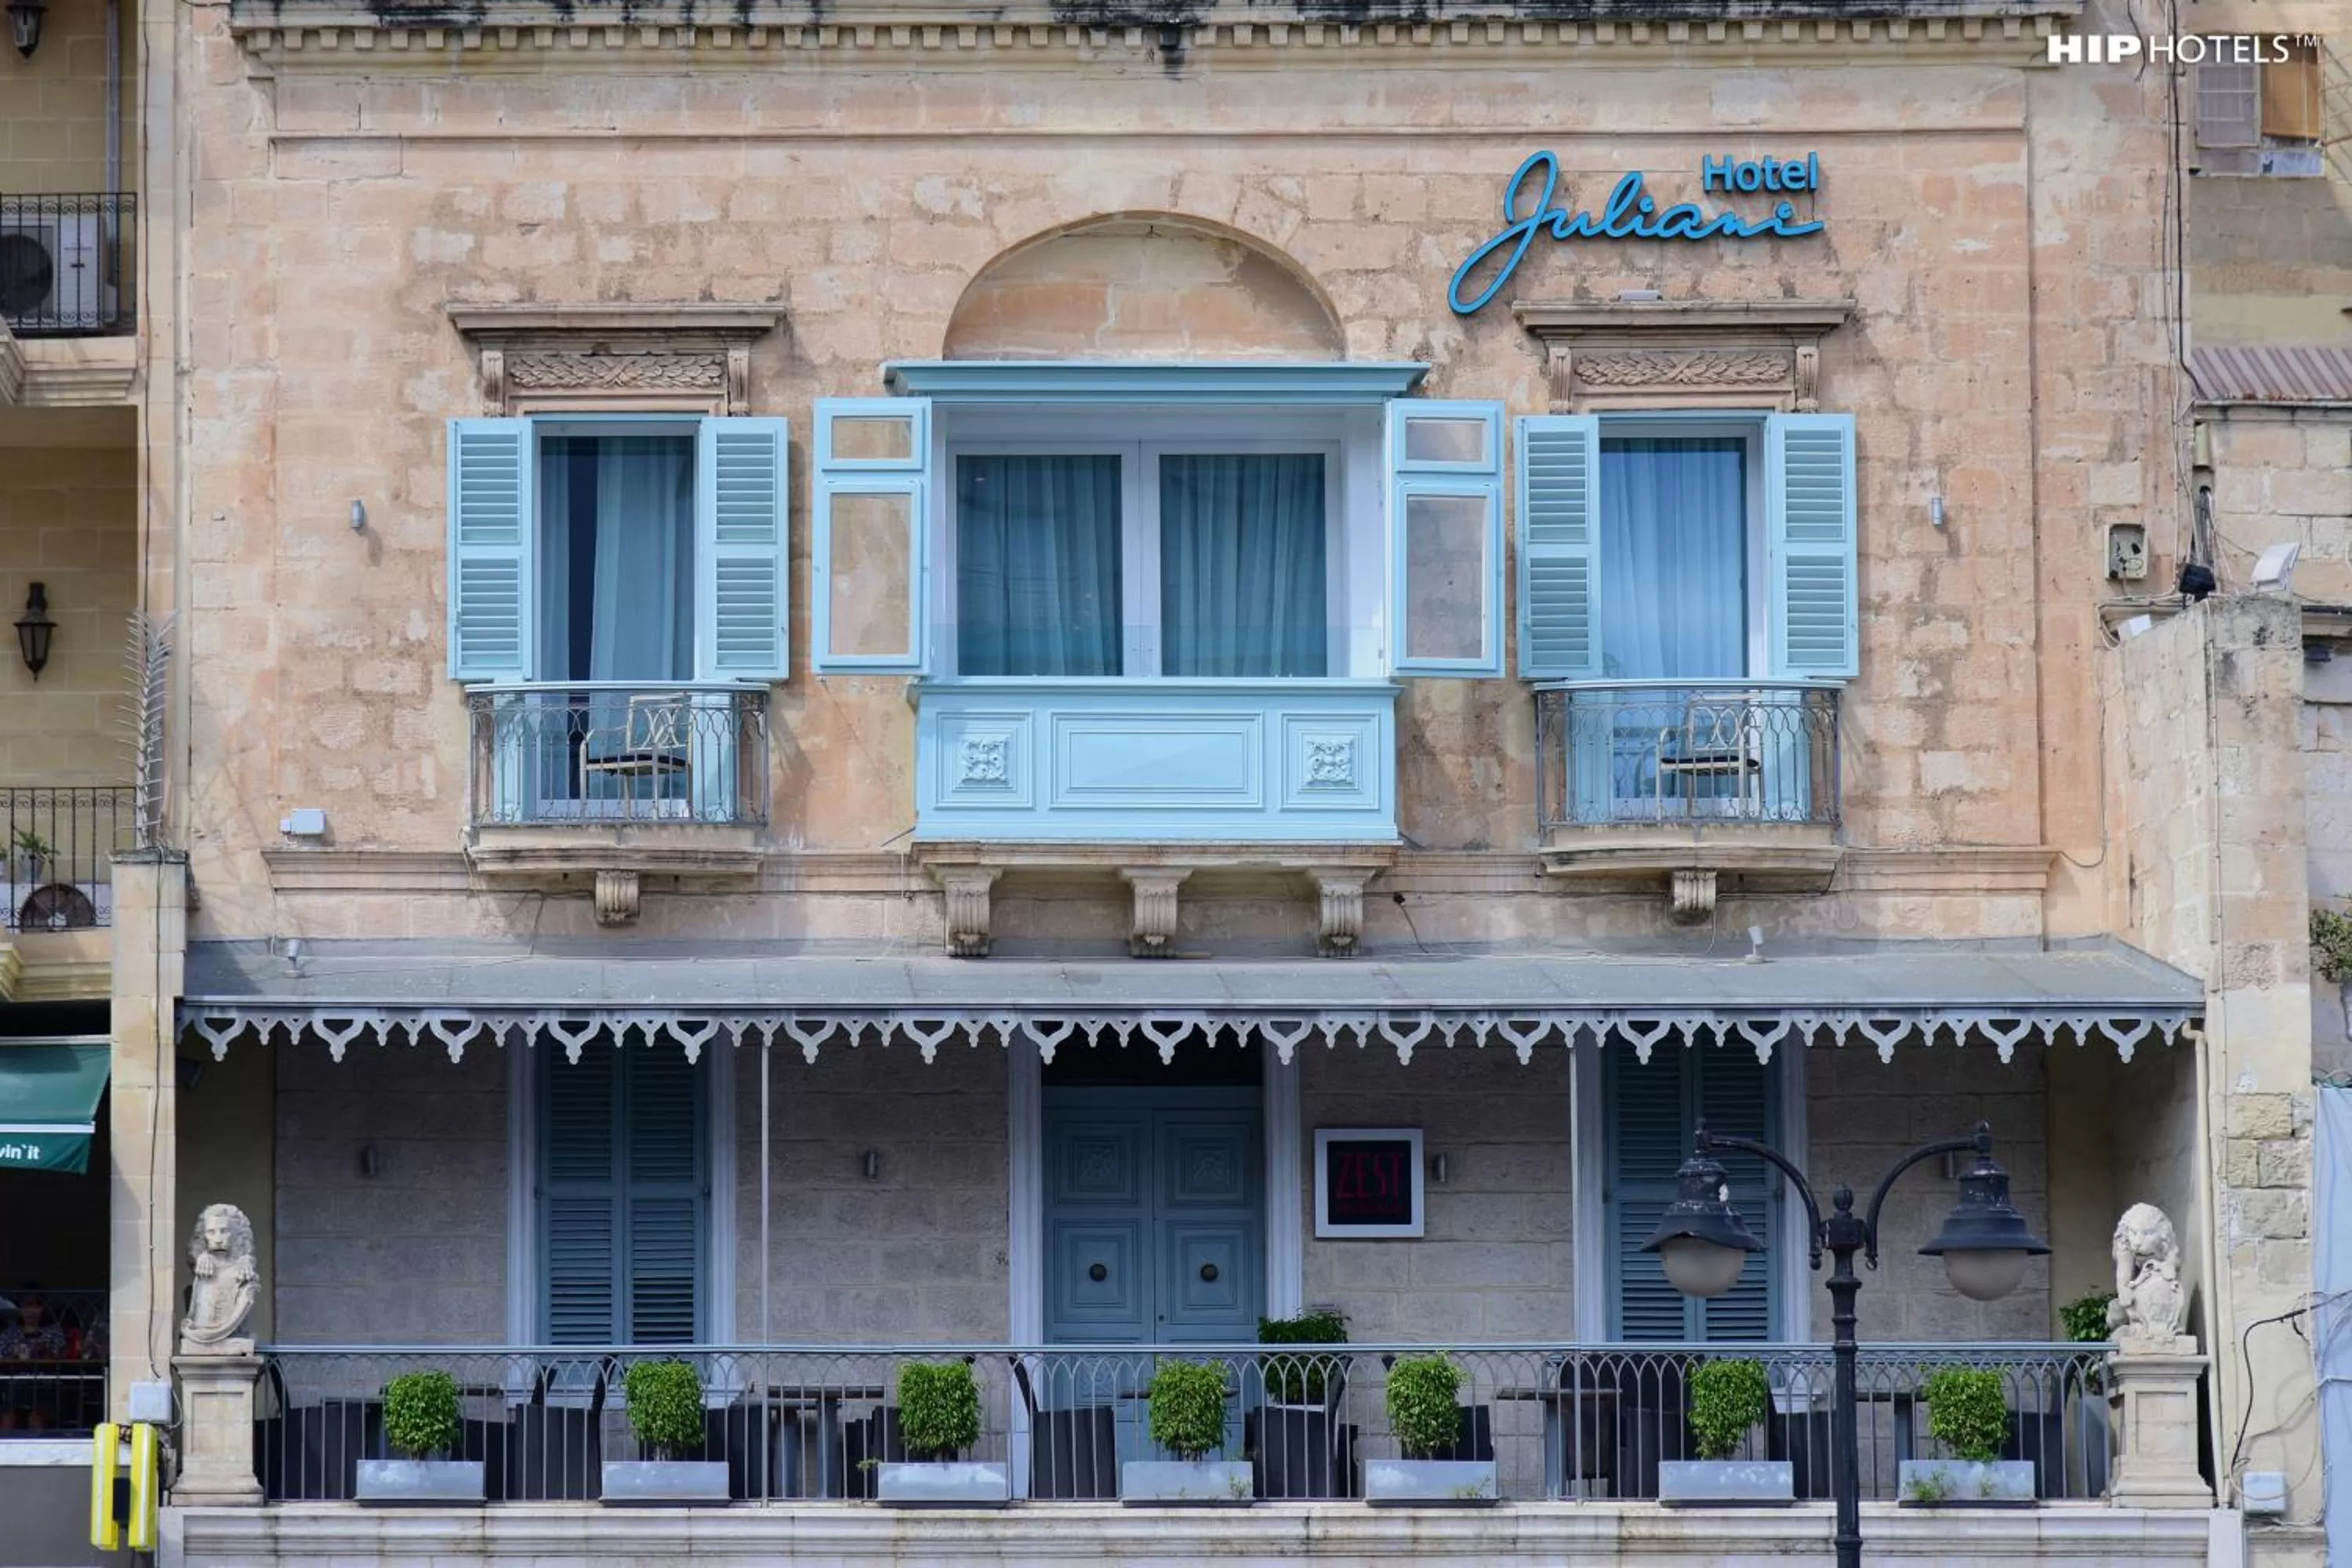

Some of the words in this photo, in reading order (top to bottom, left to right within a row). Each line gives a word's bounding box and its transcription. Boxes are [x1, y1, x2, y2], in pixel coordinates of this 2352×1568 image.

[1703, 151, 1819, 193] Hotel
[1448, 150, 1826, 314] Juliani
[1336, 1152, 1405, 1200] ZEST
